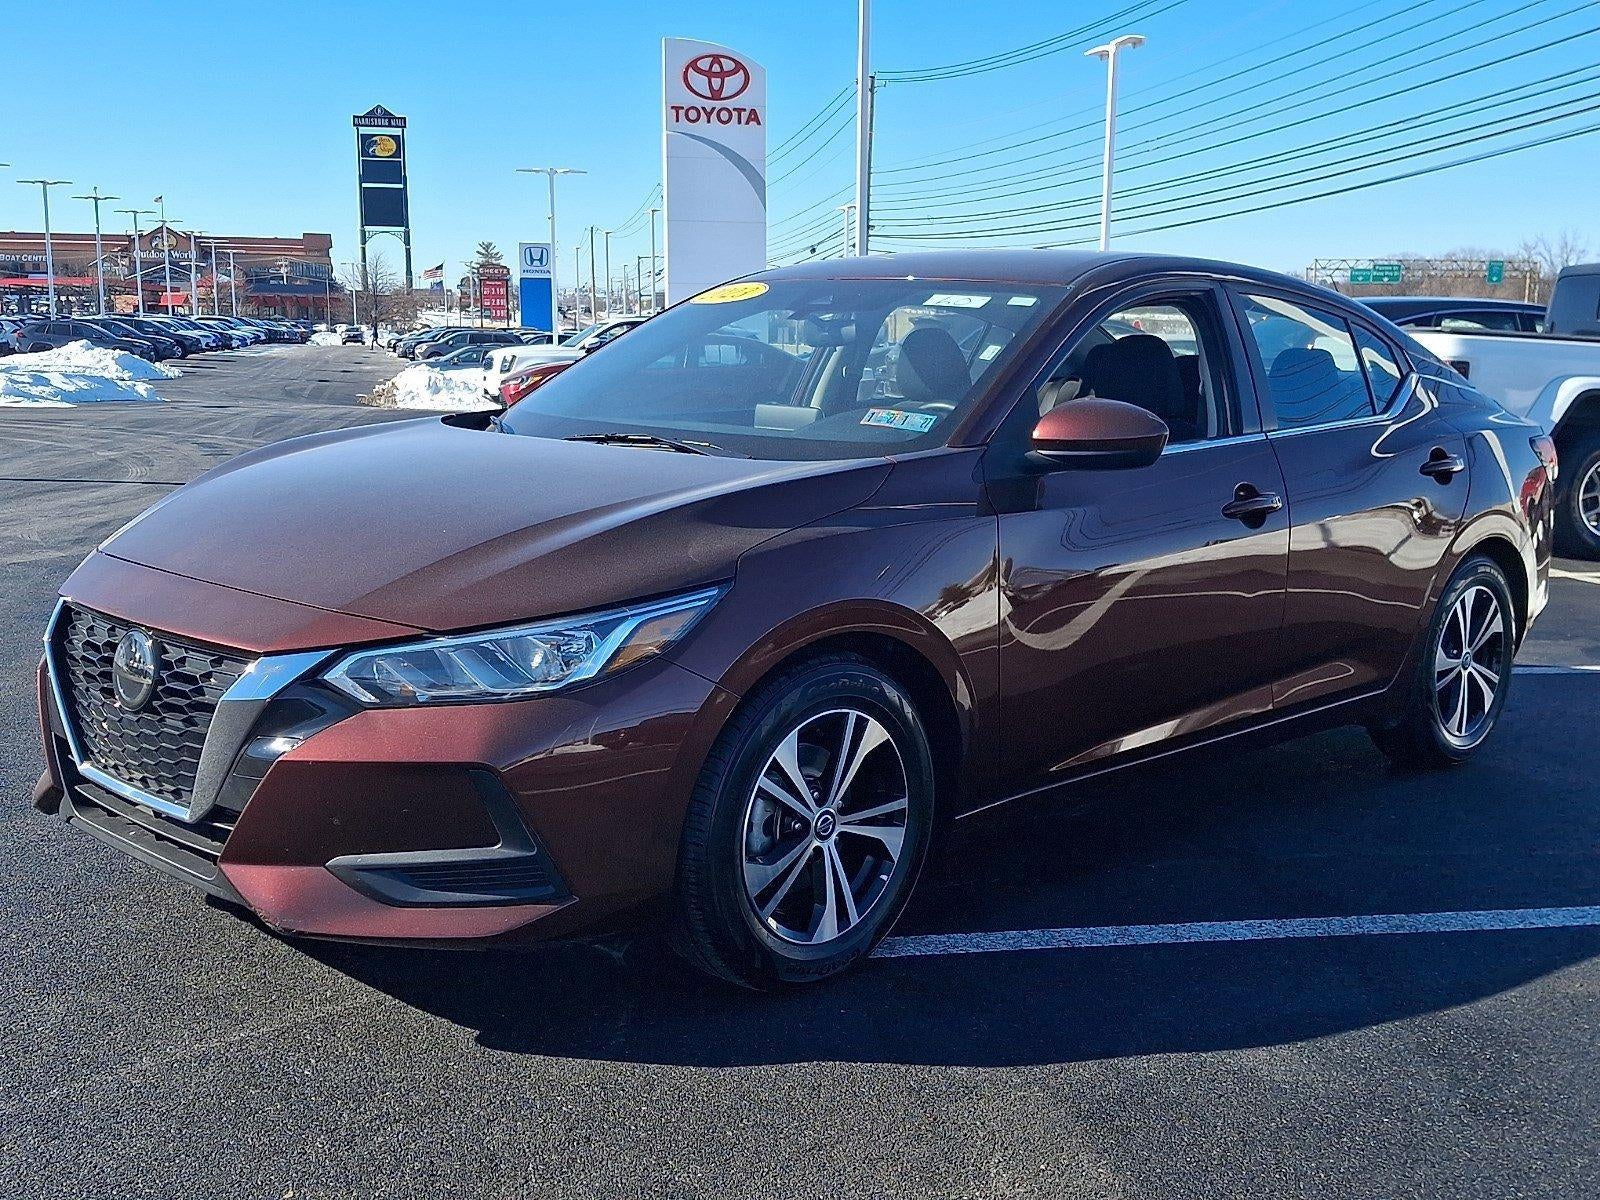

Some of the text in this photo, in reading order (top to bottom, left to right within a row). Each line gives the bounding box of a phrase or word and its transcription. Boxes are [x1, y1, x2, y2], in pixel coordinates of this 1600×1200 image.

[671, 106, 761, 125] TOYOTA
[0, 253, 48, 262] BOAT CENTE
[133, 250, 166, 259] Outdoo
